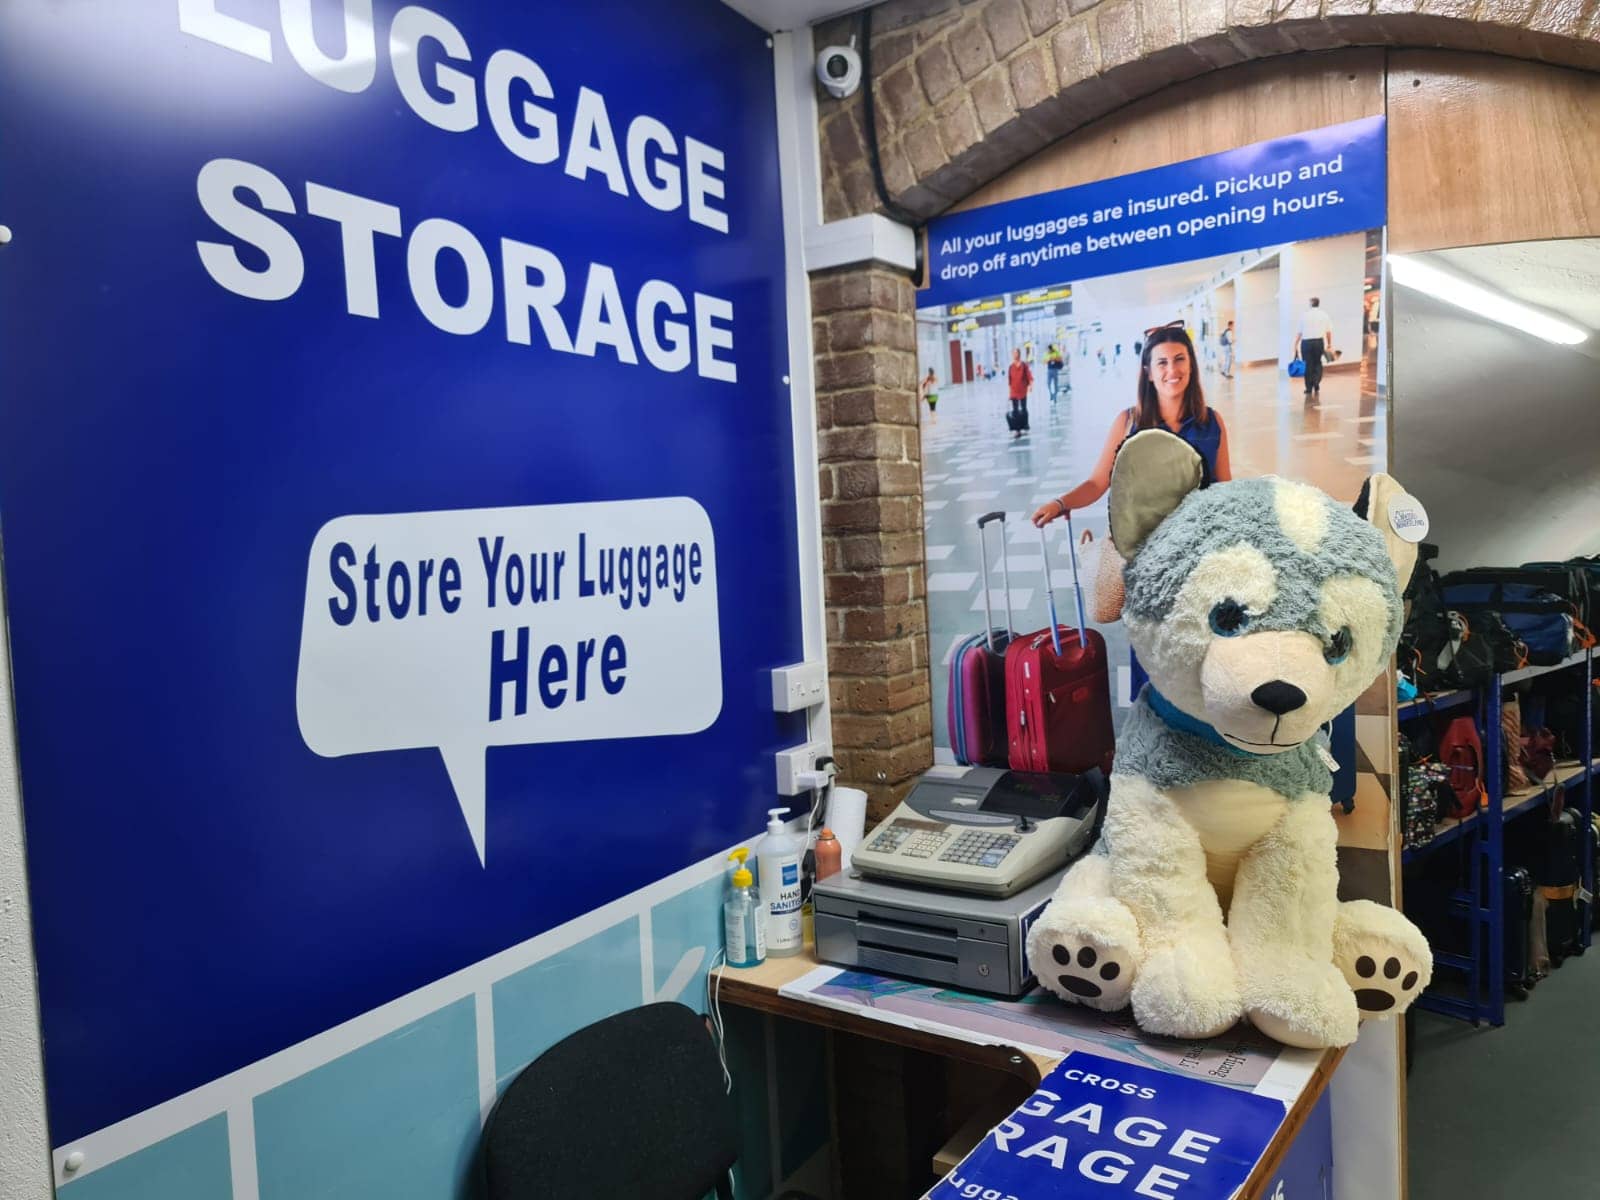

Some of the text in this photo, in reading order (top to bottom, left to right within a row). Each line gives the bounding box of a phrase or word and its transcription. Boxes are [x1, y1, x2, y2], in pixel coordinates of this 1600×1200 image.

[940, 153, 1343, 256] All your luggages are insured. Pickup and
[940, 189, 1345, 280] drop off anytime between opening hours.
[196, 158, 737, 383] STORAGE
[328, 532, 702, 627] Store Your Luggage
[488, 625, 627, 723] Here
[1018, 1089, 1221, 1164] GAGE
[1064, 1069, 1157, 1100] CROSS
[990, 1118, 1191, 1200] RAGE
